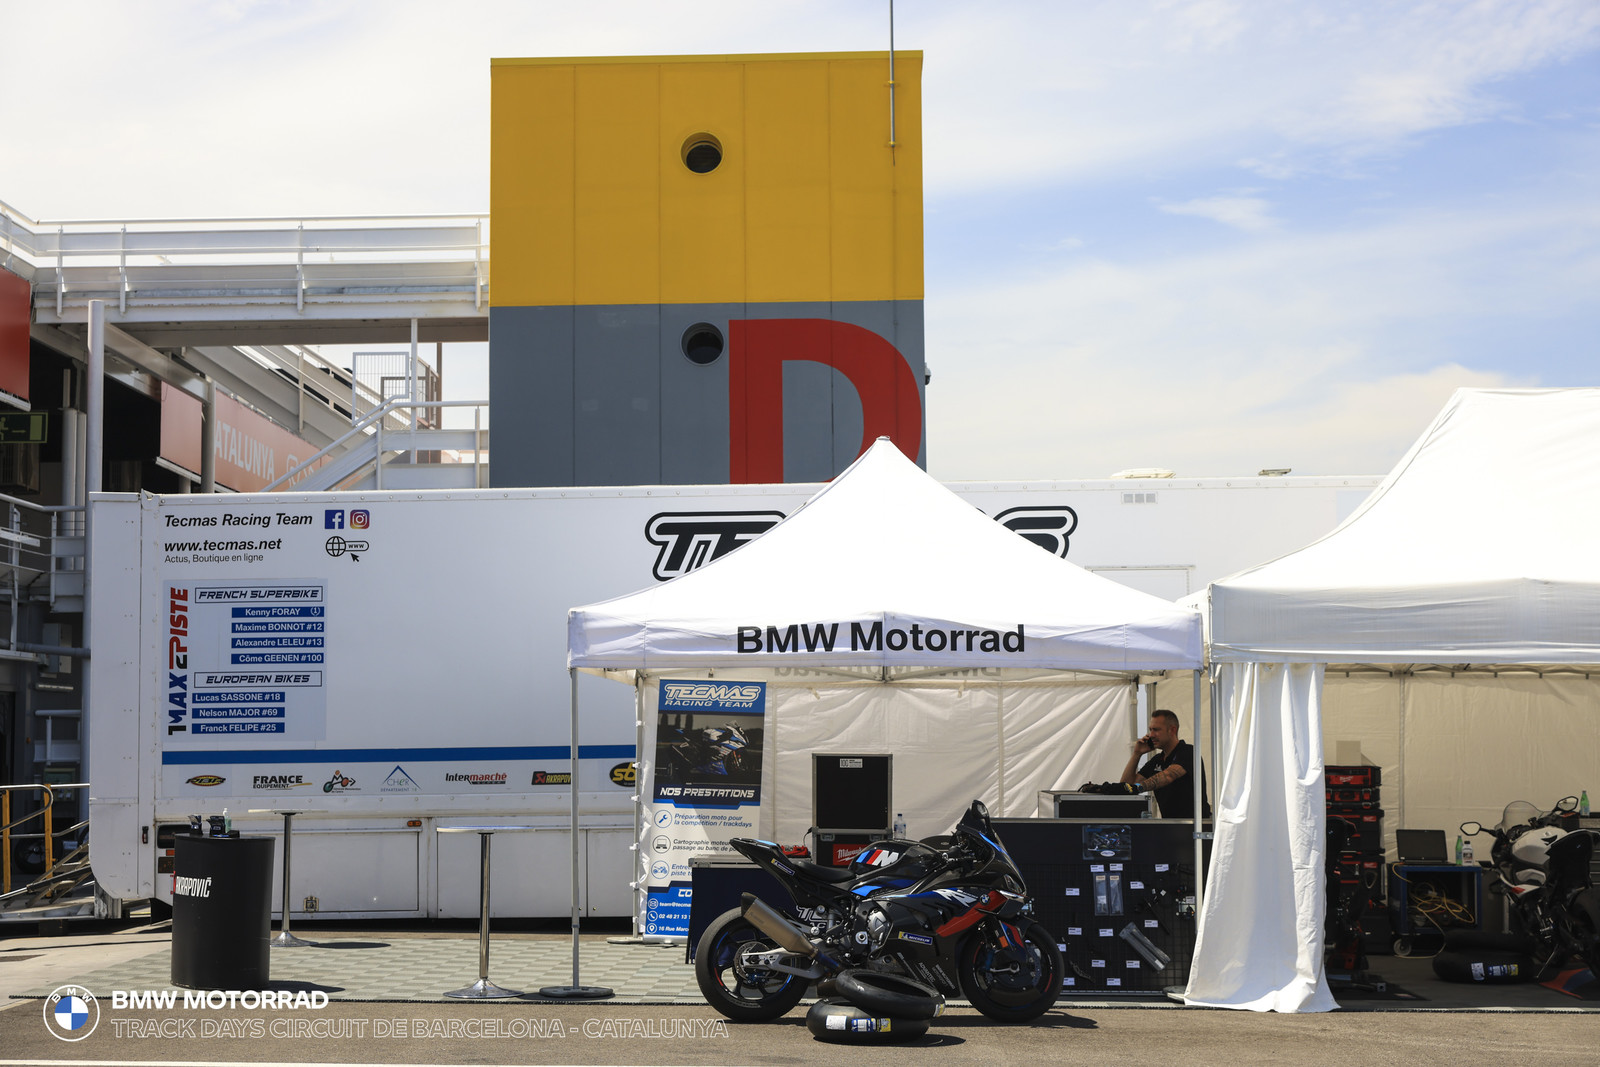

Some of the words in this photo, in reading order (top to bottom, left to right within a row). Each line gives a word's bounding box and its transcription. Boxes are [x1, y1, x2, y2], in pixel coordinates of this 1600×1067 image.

[729, 318, 922, 484] D
[215, 420, 275, 482] ATALUNYA
[164, 514, 217, 527] Tecmas
[222, 513, 271, 528] Racing
[276, 512, 312, 525] Team
[164, 538, 282, 552] www.tecmas.net
[164, 554, 191, 564] Actus,
[192, 554, 230, 564] Boutique
[244, 554, 264, 563] ligne
[199, 591, 247, 600] FRENCH
[250, 590, 319, 598] SUPERBIKE
[246, 608, 271, 617] Kenny
[737, 623, 839, 654] BMW
[850, 621, 1025, 653] Motorrad
[206, 675, 272, 684] EUROPEAN
[274, 674, 310, 682] BIKES
[664, 683, 761, 703] TECMAS
[254, 776, 303, 784] FRANCE
[660, 788, 682, 796] NOS
[683, 788, 755, 798] PRESTATIONS
